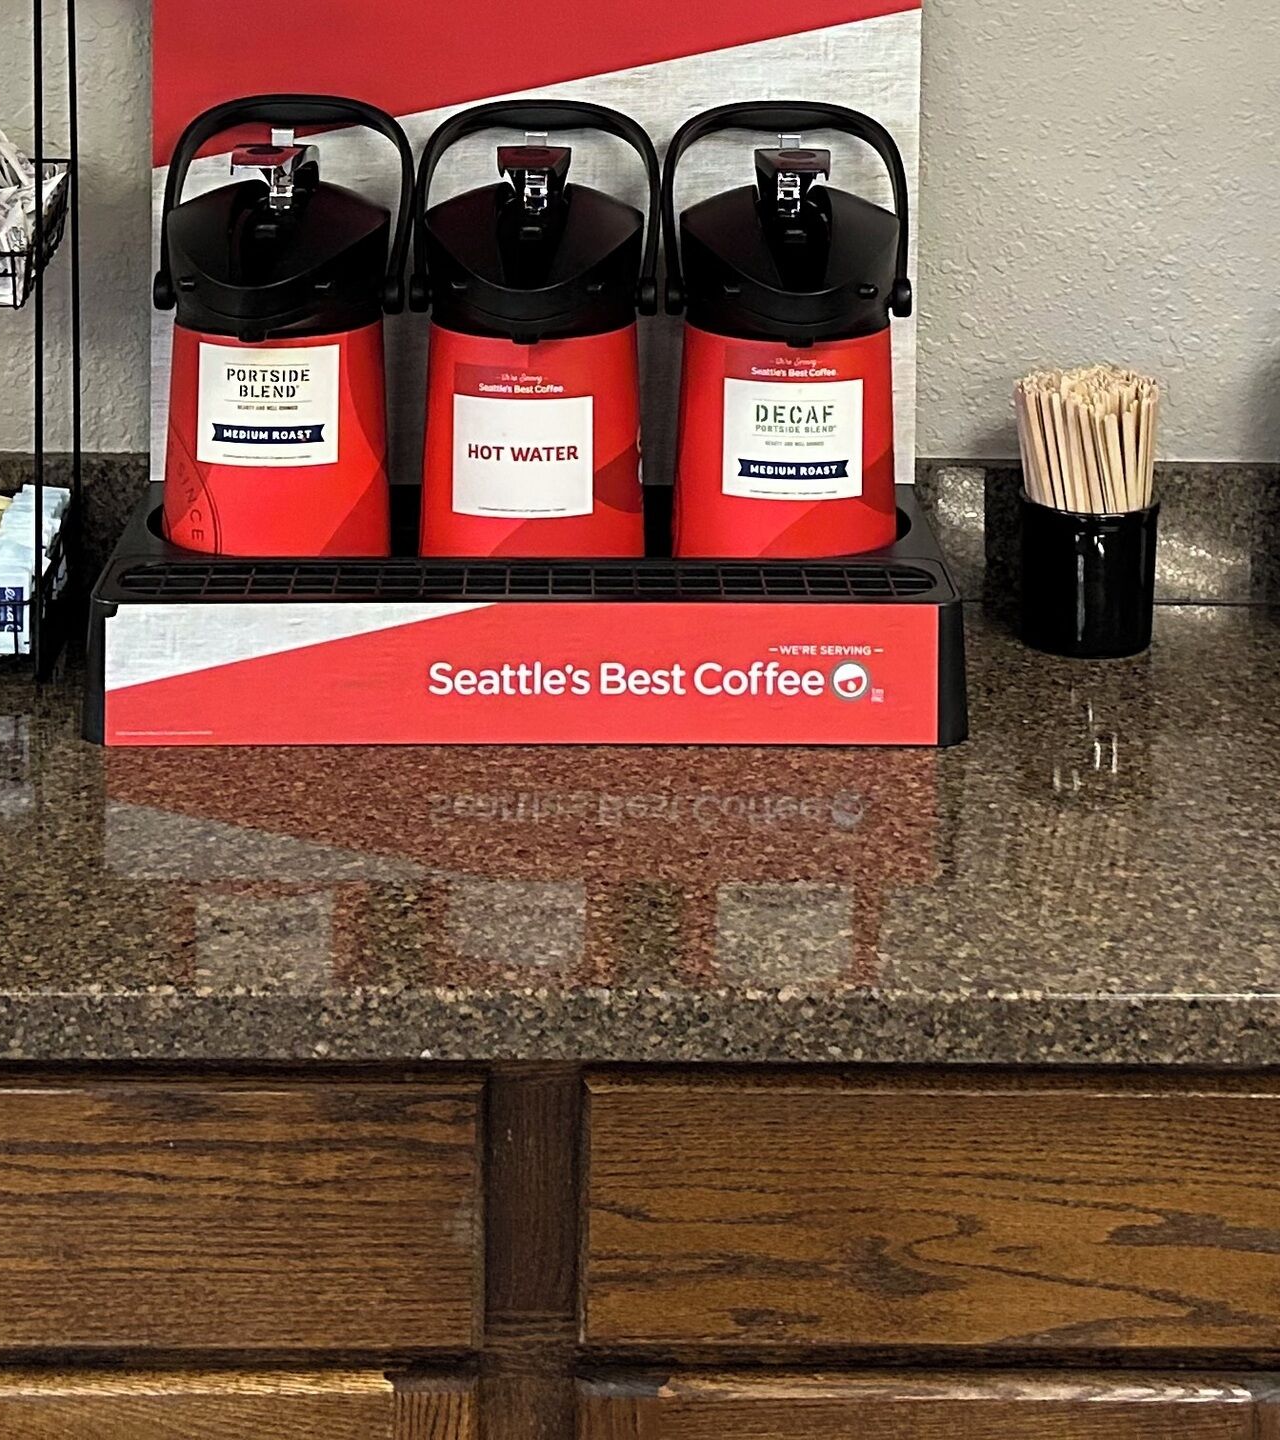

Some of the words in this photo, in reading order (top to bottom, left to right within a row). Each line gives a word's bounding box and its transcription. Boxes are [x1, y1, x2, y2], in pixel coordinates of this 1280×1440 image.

[227, 368, 310, 382] PORTSIDE
[788, 368, 808, 377] Best
[809, 367, 837, 377] Coffee
[239, 385, 297, 398] BLEND
[514, 385, 534, 394] Best
[535, 384, 564, 394] Coffee
[755, 404, 834, 424] DECAF
[223, 428, 269, 440] MEDIUM
[272, 430, 312, 440] ROAST
[755, 424, 800, 433] PORTSIDE
[468, 443, 504, 461] HOT
[510, 445, 579, 462] WATER
[749, 464, 797, 476] MEDIUM
[799, 465, 838, 476] ROAST
[779, 645, 817, 655] WE'RE
[820, 645, 872, 656] SERVING
[428, 661, 591, 696] Seattle's
[600, 662, 686, 696] Best
[693, 661, 825, 696] Coffee
